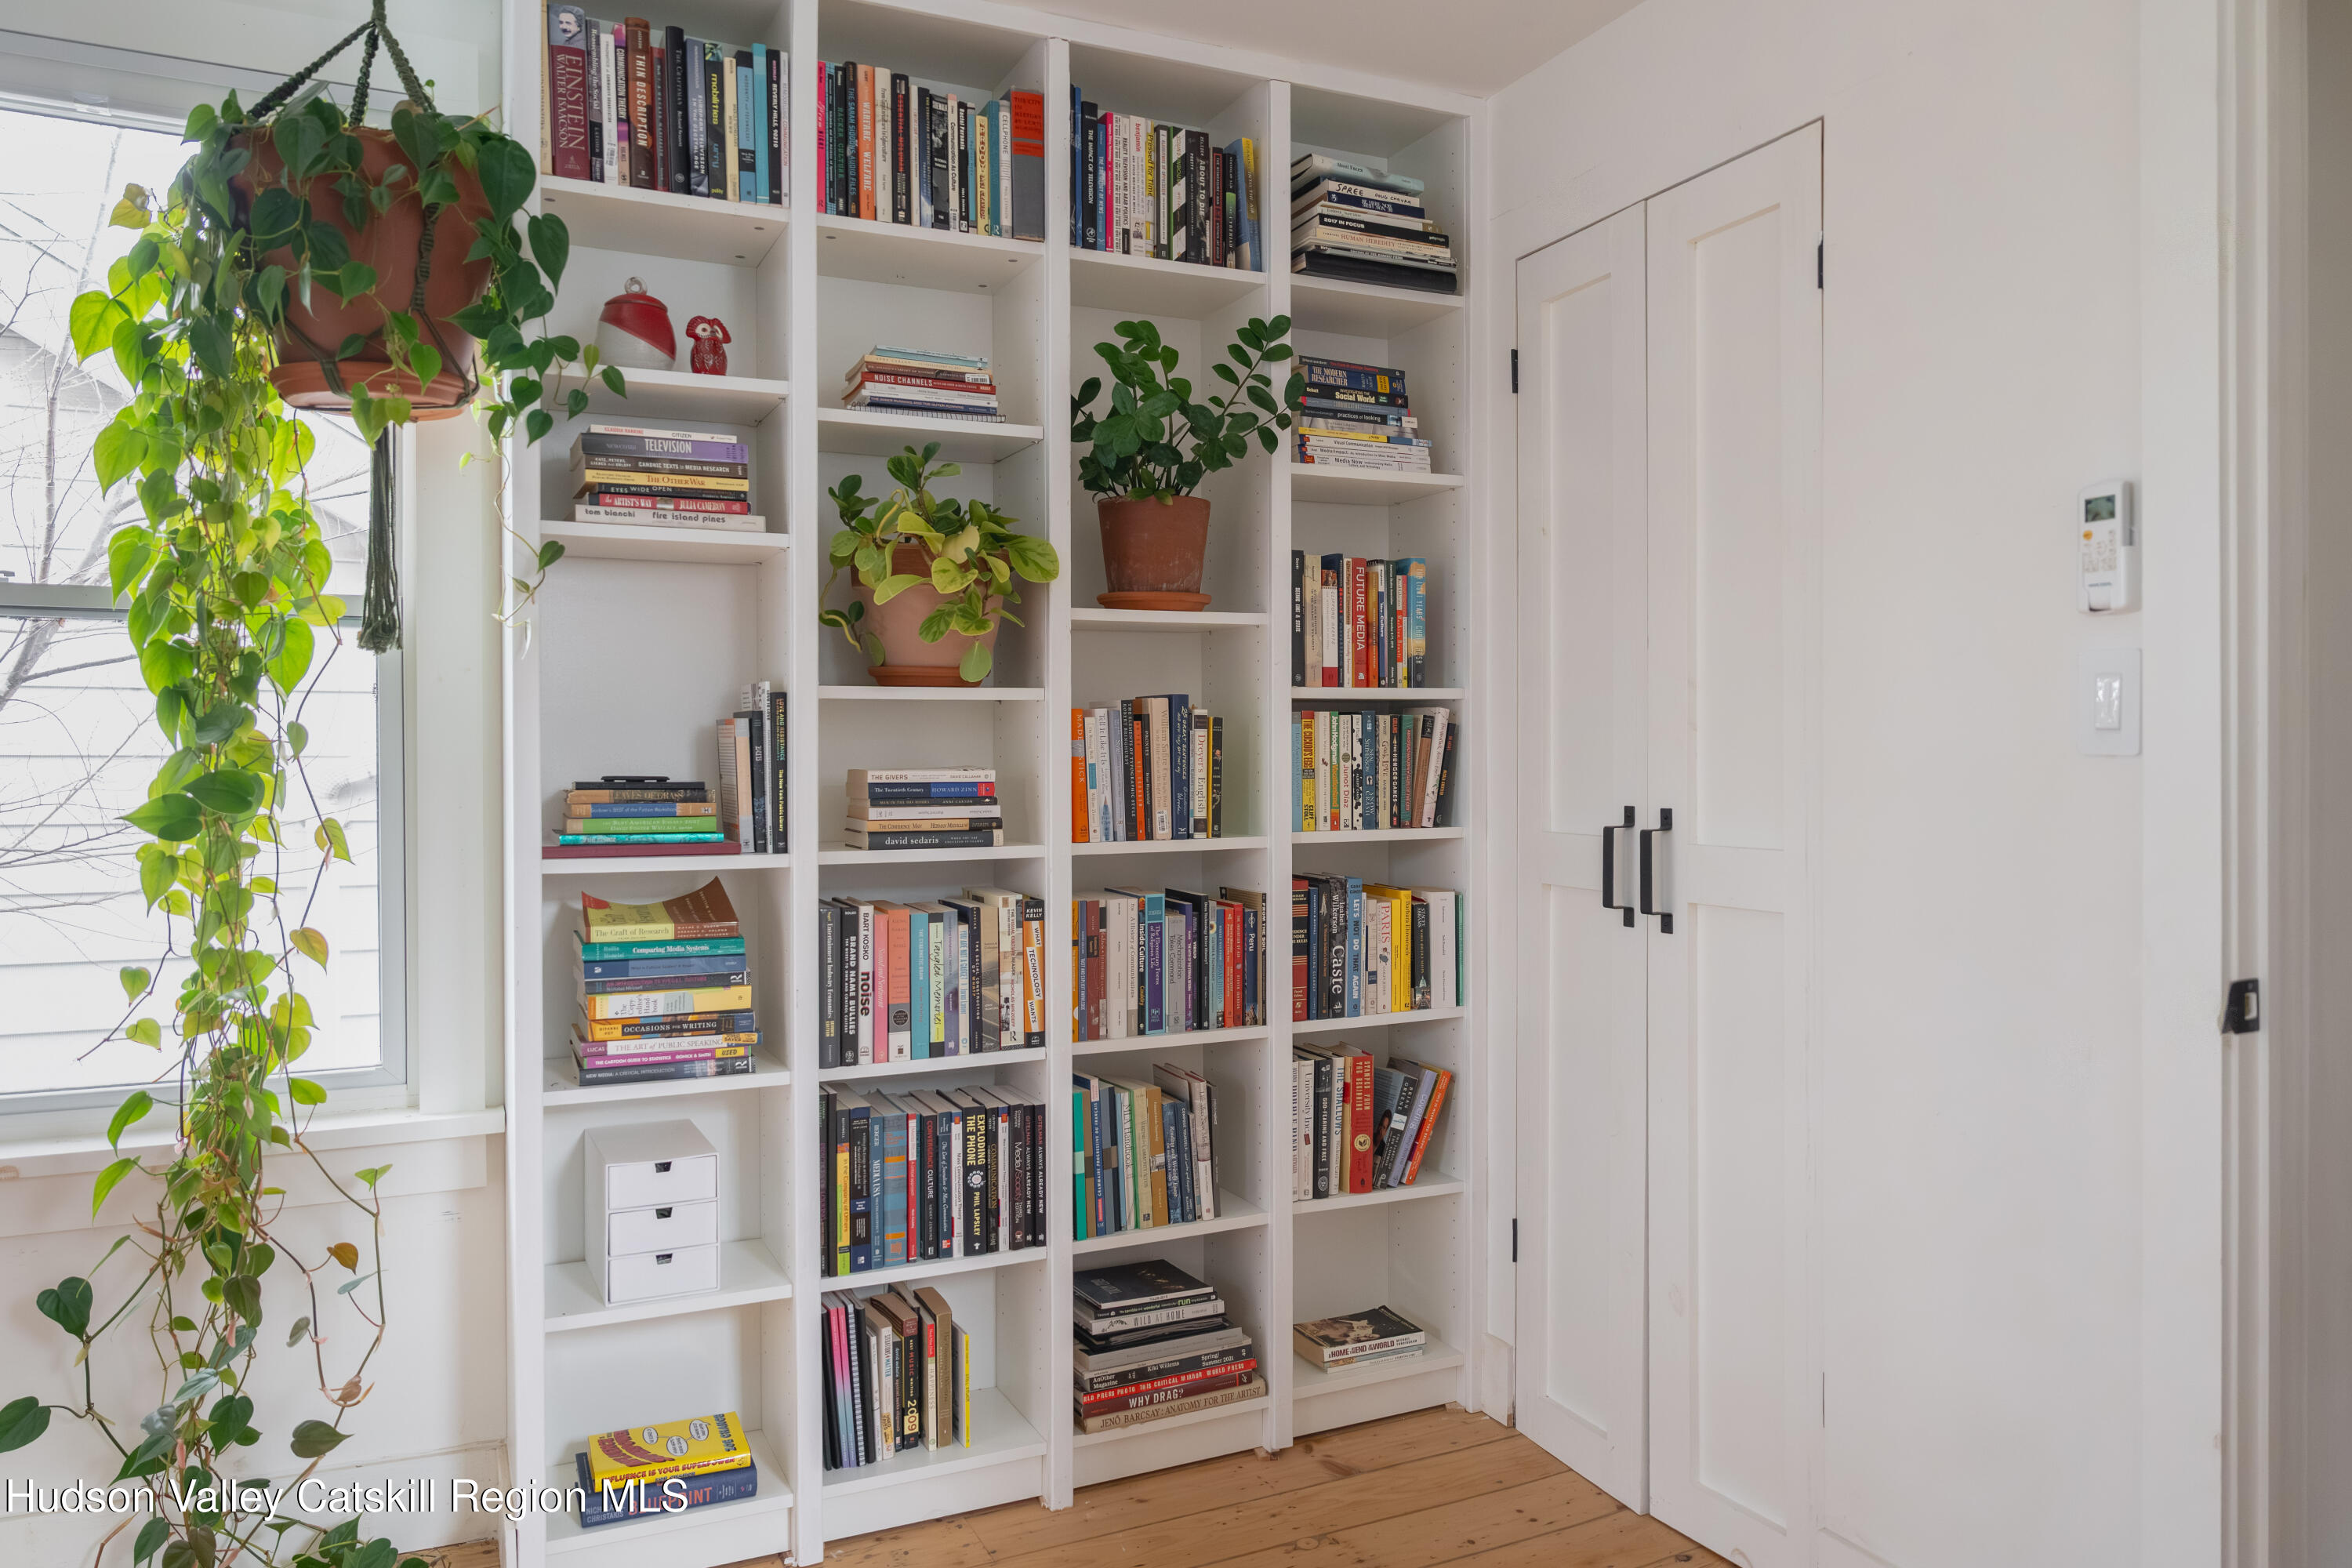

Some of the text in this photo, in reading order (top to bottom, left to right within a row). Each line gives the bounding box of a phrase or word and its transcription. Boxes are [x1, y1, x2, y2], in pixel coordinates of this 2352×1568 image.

[616, 48, 627, 119] COMMUNICATION THEORY
[556, 53, 569, 148] WALTER ISAACSON
[564, 55, 585, 151] EINSTEIN
[636, 55, 648, 147] THIN DESCRIPTION
[711, 74, 720, 125] mobilities
[862, 102, 871, 142] WARFARE
[863, 151, 872, 191] WELFARE
[1088, 163, 1094, 172] OF
[1199, 190, 1205, 200] TO
[1336, 183, 1364, 197] SPREE
[874, 374, 933, 387] NOISE CHANNELS
[1335, 392, 1375, 403] Social World
[644, 439, 691, 453] TELEVISION
[611, 485, 629, 494] EYES
[615, 496, 653, 507] ARTIST'S WAY
[586, 508, 726, 524] tom bianchi fire island pines
[679, 499, 726, 511] JULIA CAMERON
[1356, 615, 1365, 651] MEDIA
[1303, 720, 1312, 768] THE CUCKOO'S EGG
[1195, 735, 1207, 813] Dreyer's English
[885, 835, 939, 845] david sedaris
[596, 927, 670, 938] The Craft of Research
[1381, 906, 1391, 944] PARIS
[1353, 938, 1359, 950] DO
[930, 940, 943, 1025] Tangled Memories
[1029, 949, 1041, 998] TECHNOLOGY
[1331, 945, 1345, 994] Caste
[861, 971, 871, 1016] noise
[624, 1024, 671, 1033] OCCASIONS
[682, 1022, 717, 1030] WRITING
[1334, 1087, 1344, 1136] SHALLOWS
[967, 1116, 976, 1167] THE PHONE
[977, 1115, 985, 1165] EXPLODING
[1122, 1104, 1133, 1168] MLA Handbook
[1014, 1142, 1022, 1201] Media/Society
[1178, 1298, 1191, 1307] run
[1133, 1308, 1185, 1327] WILD AT HOME
[1160, 1361, 1179, 1370] Willems
[1201, 1352, 1221, 1363] Spring/
[1092, 1374, 1116, 1383] AnOther
[1092, 1380, 1118, 1389] Magazine
[1128, 1388, 1184, 1408] WHY DRAG?
[1164, 1399, 1202, 1415] ANATOMY
[1203, 1396, 1218, 1406] FOR
[1220, 1392, 1234, 1403] THE
[1236, 1386, 1260, 1400] ARTIST
[907, 1399, 916, 1431] 2009
[601, 1472, 646, 1484] INFLUENCE
[659, 1465, 680, 1475] YOUR
[682, 1457, 735, 1472] SUPERPOWER
